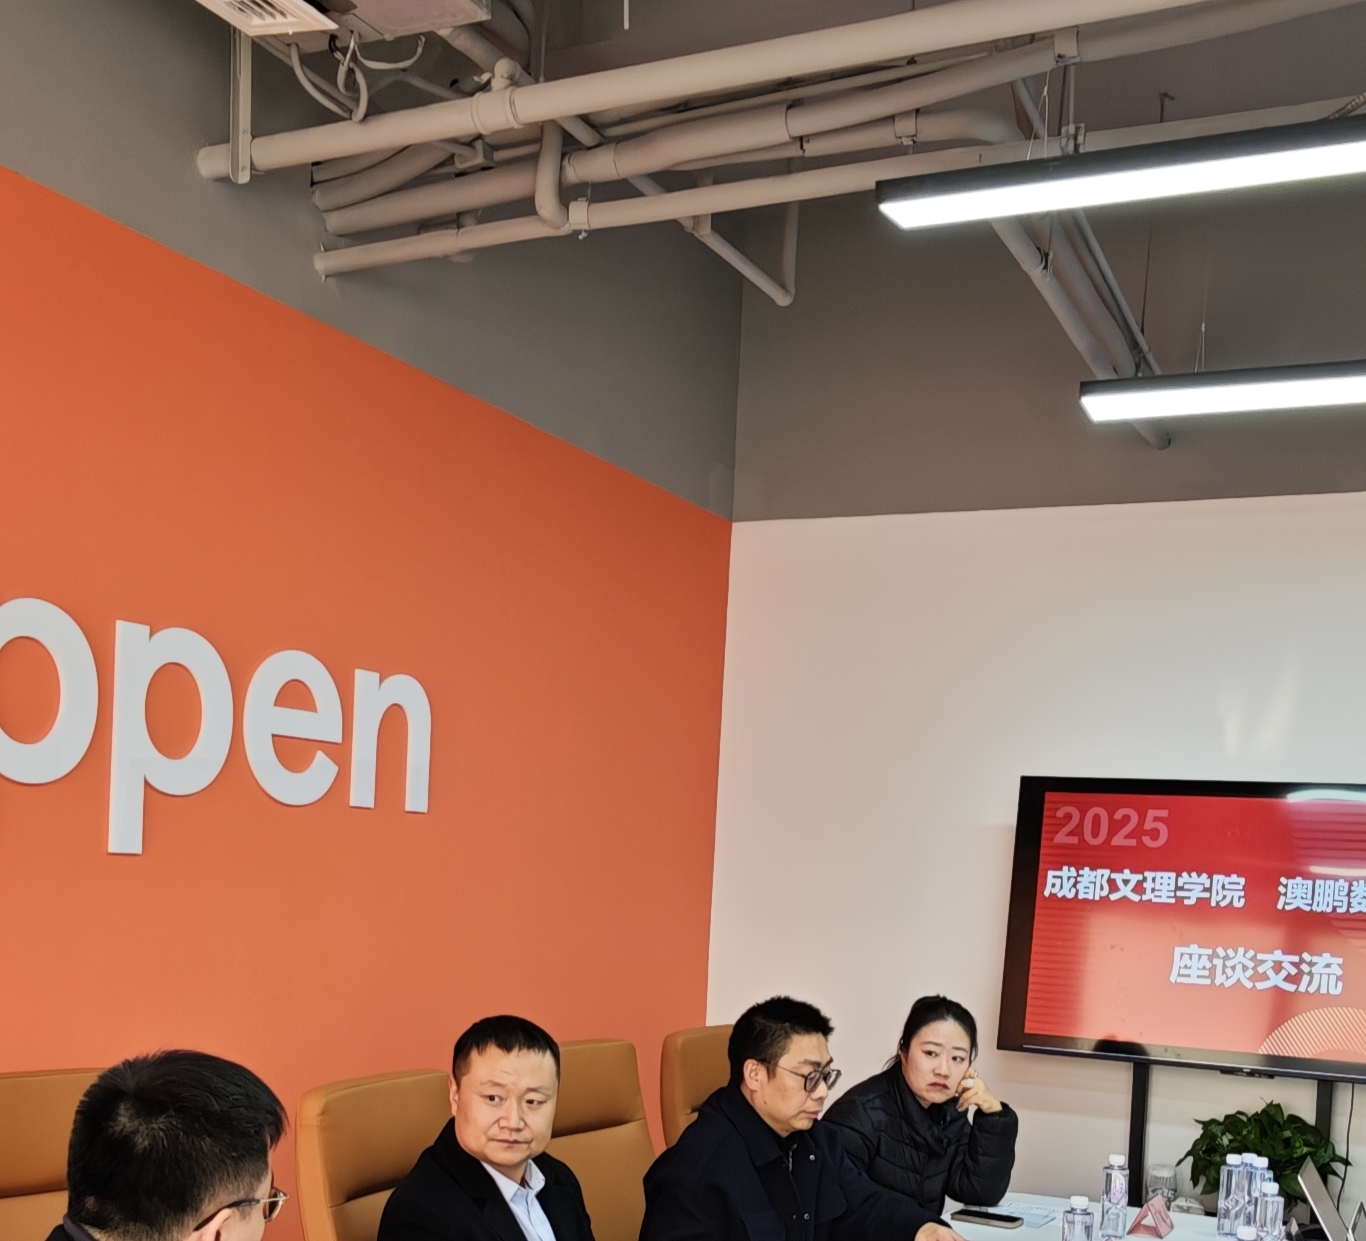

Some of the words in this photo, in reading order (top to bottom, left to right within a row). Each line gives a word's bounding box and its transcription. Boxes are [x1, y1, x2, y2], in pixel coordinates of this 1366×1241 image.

[1053, 804, 1170, 849] 2025
[1044, 866, 1246, 908] 成都文理学院
[1168, 943, 1345, 996] 座谈交流
